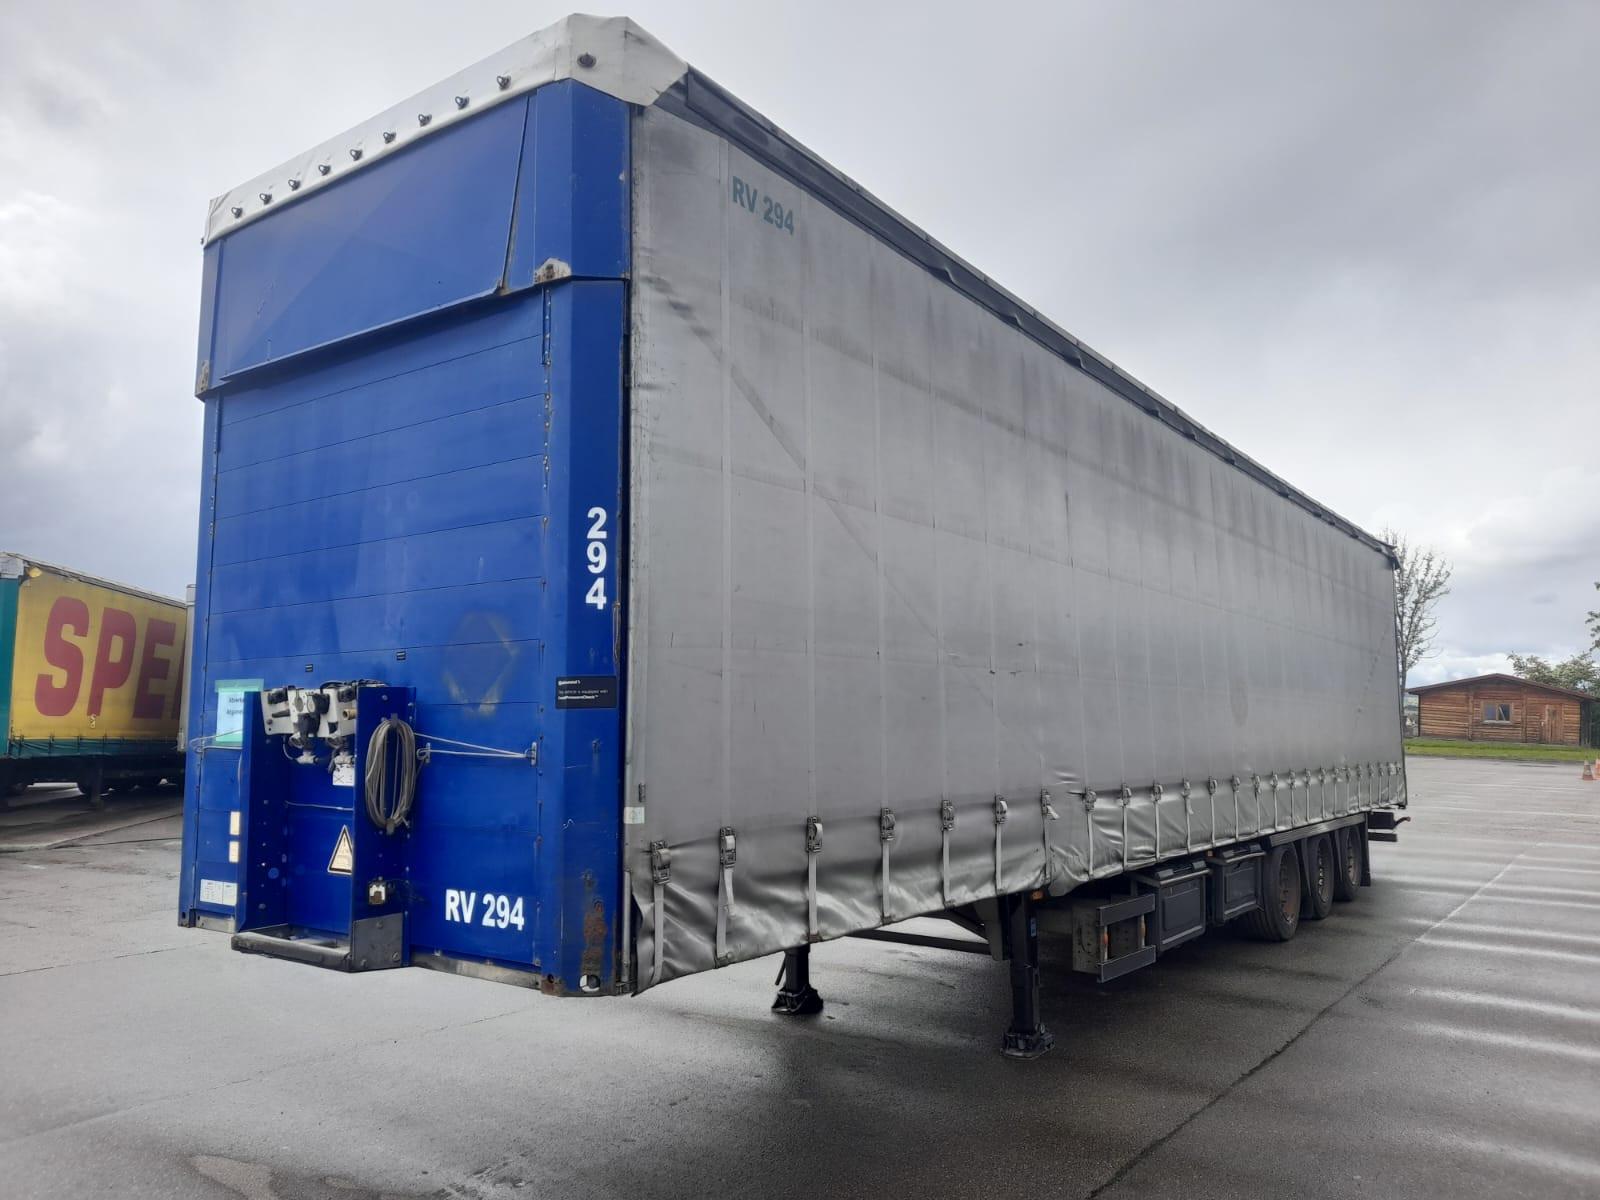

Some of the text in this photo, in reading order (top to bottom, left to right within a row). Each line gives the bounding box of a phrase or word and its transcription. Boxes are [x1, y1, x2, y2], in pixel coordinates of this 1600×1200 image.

[732, 175, 794, 236] RV 294
[585, 506, 607, 610] 294
[34, 596, 184, 720] SPE
[445, 888, 525, 931] RV 294
